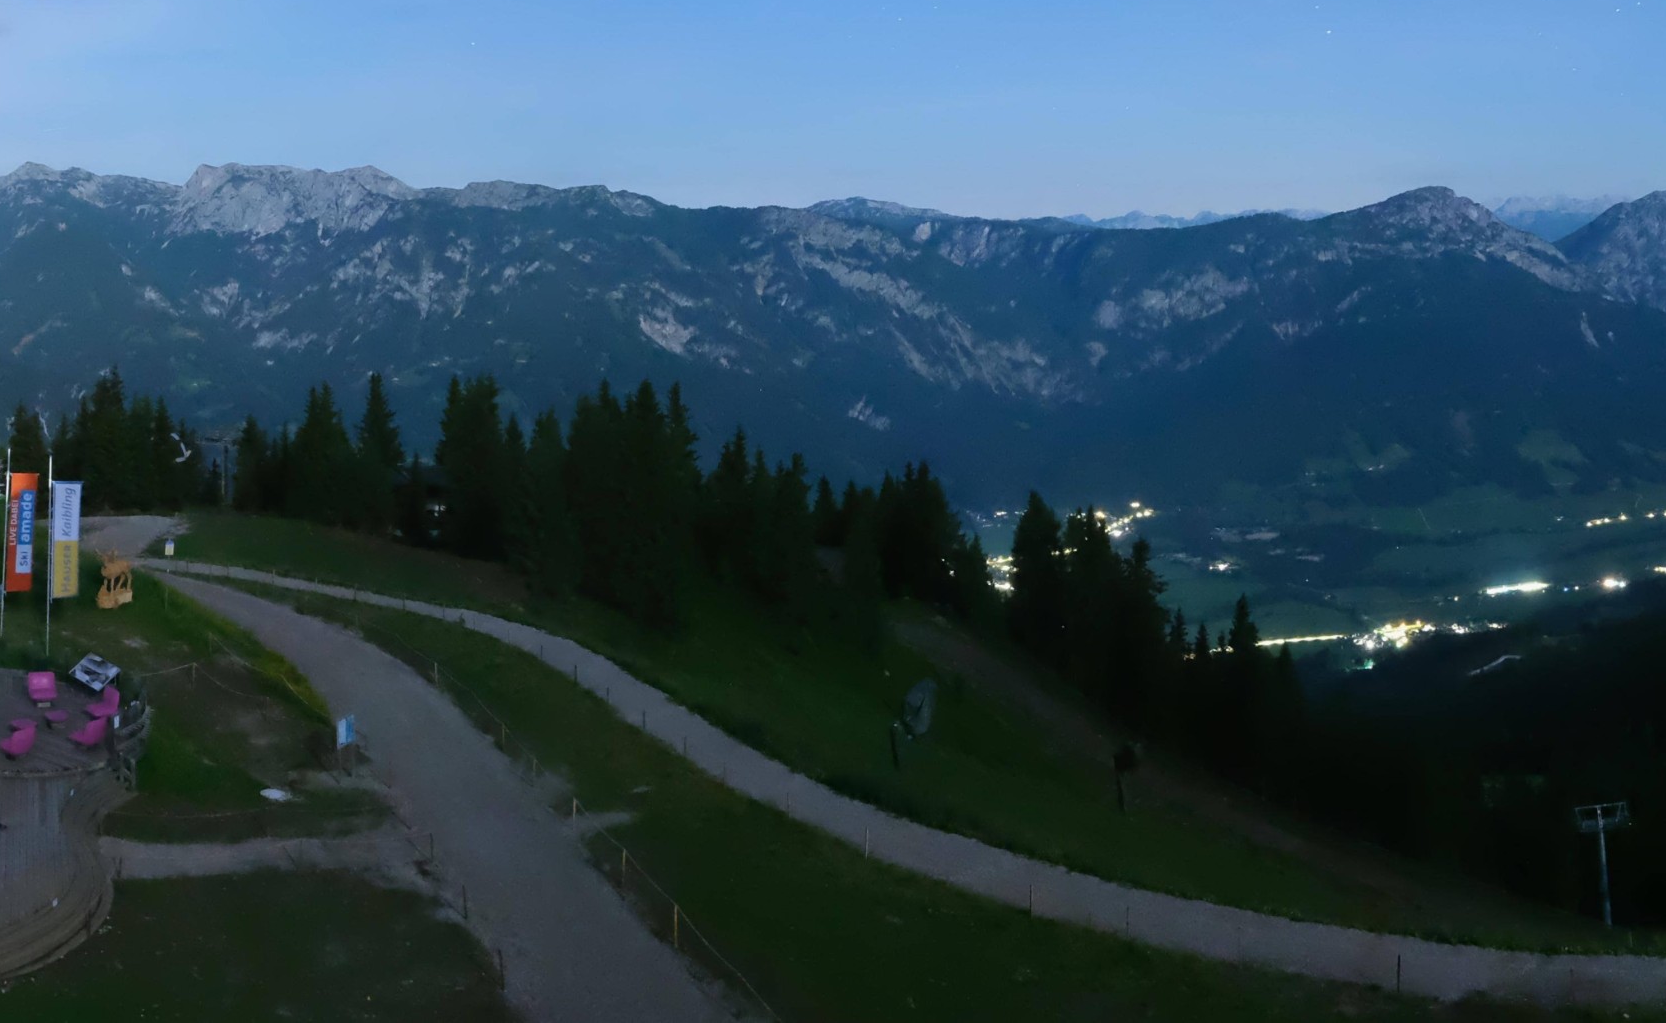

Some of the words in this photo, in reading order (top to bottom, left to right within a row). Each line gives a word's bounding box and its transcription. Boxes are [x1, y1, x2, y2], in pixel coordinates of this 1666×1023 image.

[11, 499, 19, 524] DABEI
[61, 487, 77, 537] Kaibling
[9, 525, 17, 546] LIVE
[19, 551, 29, 567] Ski
